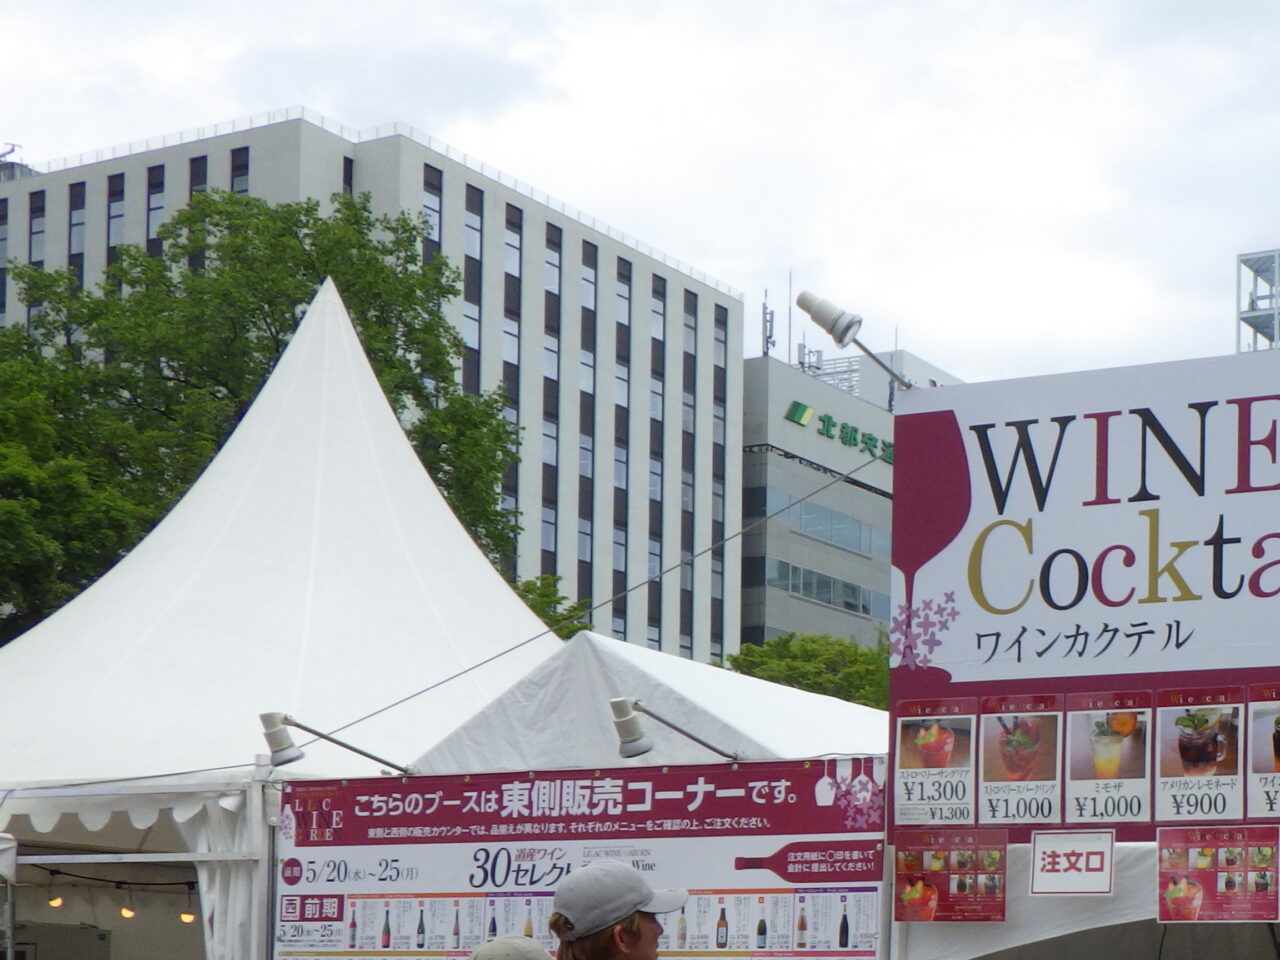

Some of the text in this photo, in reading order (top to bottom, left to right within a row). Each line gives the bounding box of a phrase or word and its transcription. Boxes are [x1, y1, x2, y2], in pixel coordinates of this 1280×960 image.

[975, 619, 1196, 664] ワインカクテル
[903, 780, 966, 803] ¥1,300
[1094, 782, 1124, 793] ミモザ
[1160, 777, 1237, 792] アメリカンレモネード
[295, 798, 331, 811] LLC
[354, 776, 797, 818] こちらのブースは東側販売コーナーです。
[988, 797, 1052, 820] ¥1,000
[1075, 795, 1141, 820] ¥1,000
[1171, 792, 1227, 815] ¥900
[929, 806, 970, 821] ¥1,300
[469, 847, 511, 888] 30
[1040, 850, 1105, 874] 注文口
[304, 897, 339, 919] 前期
